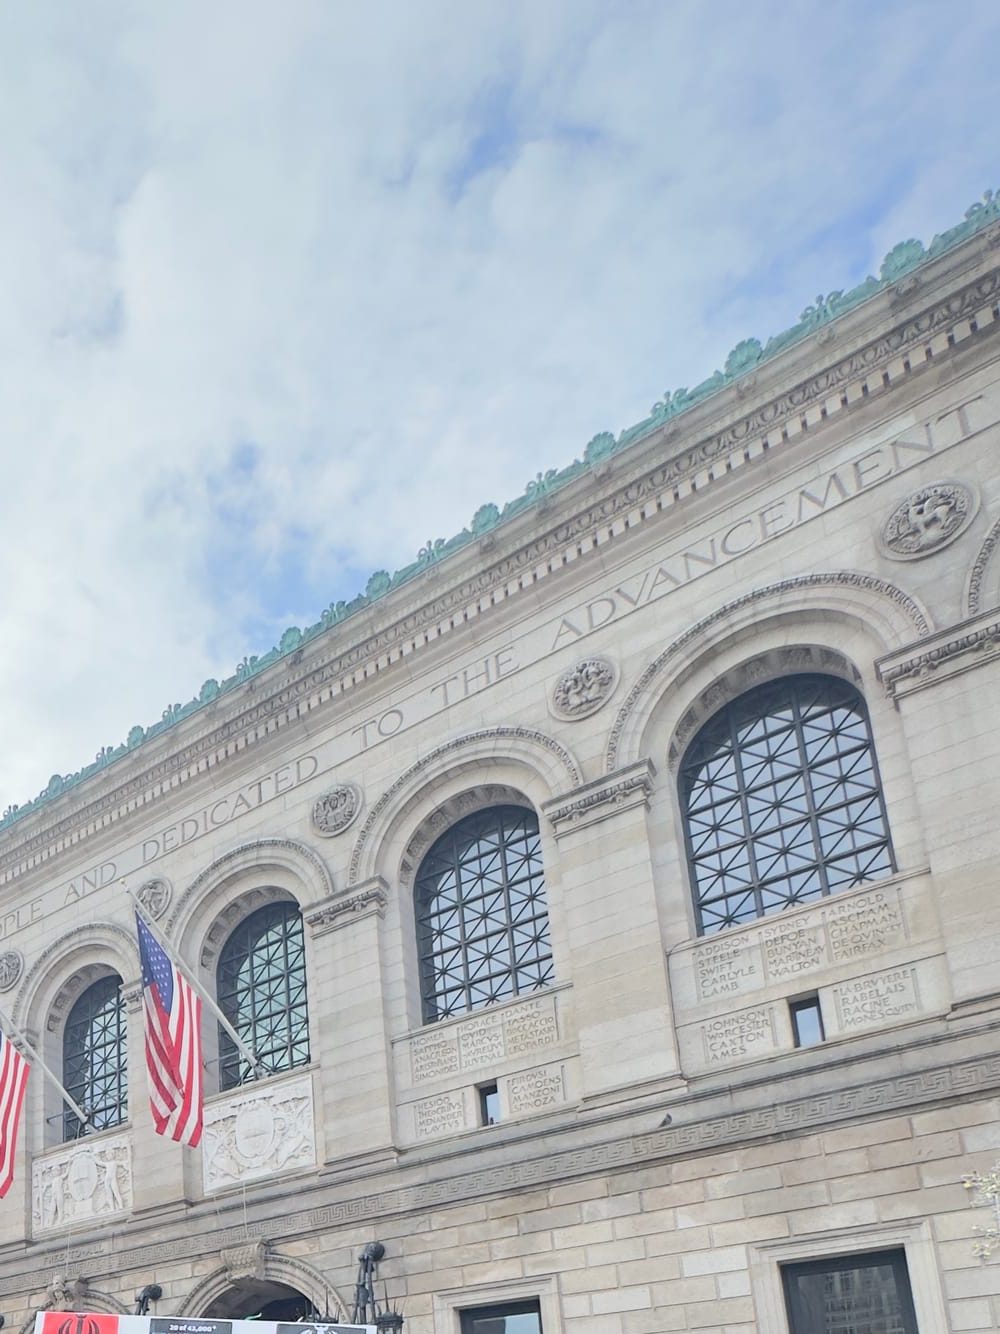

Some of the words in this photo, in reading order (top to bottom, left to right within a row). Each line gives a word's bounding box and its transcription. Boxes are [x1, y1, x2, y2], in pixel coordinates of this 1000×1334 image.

[63, 861, 117, 904] AND
[141, 754, 320, 860] DEDICATED
[352, 708, 404, 748] TO
[430, 645, 520, 707] THE
[552, 393, 985, 651] ADVANCEMENT
[829, 893, 884, 916] ARNOLD
[830, 903, 889, 928] ASCHAM
[831, 911, 897, 939] CHAPMAN
[764, 915, 810, 938] SYDNEY
[697, 935, 749, 958] ADDISON
[765, 929, 806, 948] DEFOE
[767, 935, 817, 958] BUNYAN
[832, 937, 849, 950] DE
[833, 938, 887, 960] FAIRFAX
[698, 949, 741, 969] STEELE
[769, 957, 820, 977] WALTON
[700, 961, 734, 979] SWIFT
[701, 965, 757, 988] CARLYLE
[702, 980, 738, 998] LAMB
[841, 982, 905, 1007] RABELAIS
[505, 1000, 543, 1018] DANTE
[843, 996, 890, 1018] RACINE
[507, 1010, 541, 1027] TASSO
[707, 1008, 765, 1033] JOHNSON
[461, 1028, 487, 1041] OVID
[707, 1018, 770, 1041] WORCESTER
[710, 1030, 765, 1051] CAXTON
[711, 1044, 747, 1063] AMES
[511, 1075, 561, 1095] CAMOENS
[512, 1085, 560, 1105] MANZONI
[512, 1096, 557, 1112] SPINOZA
